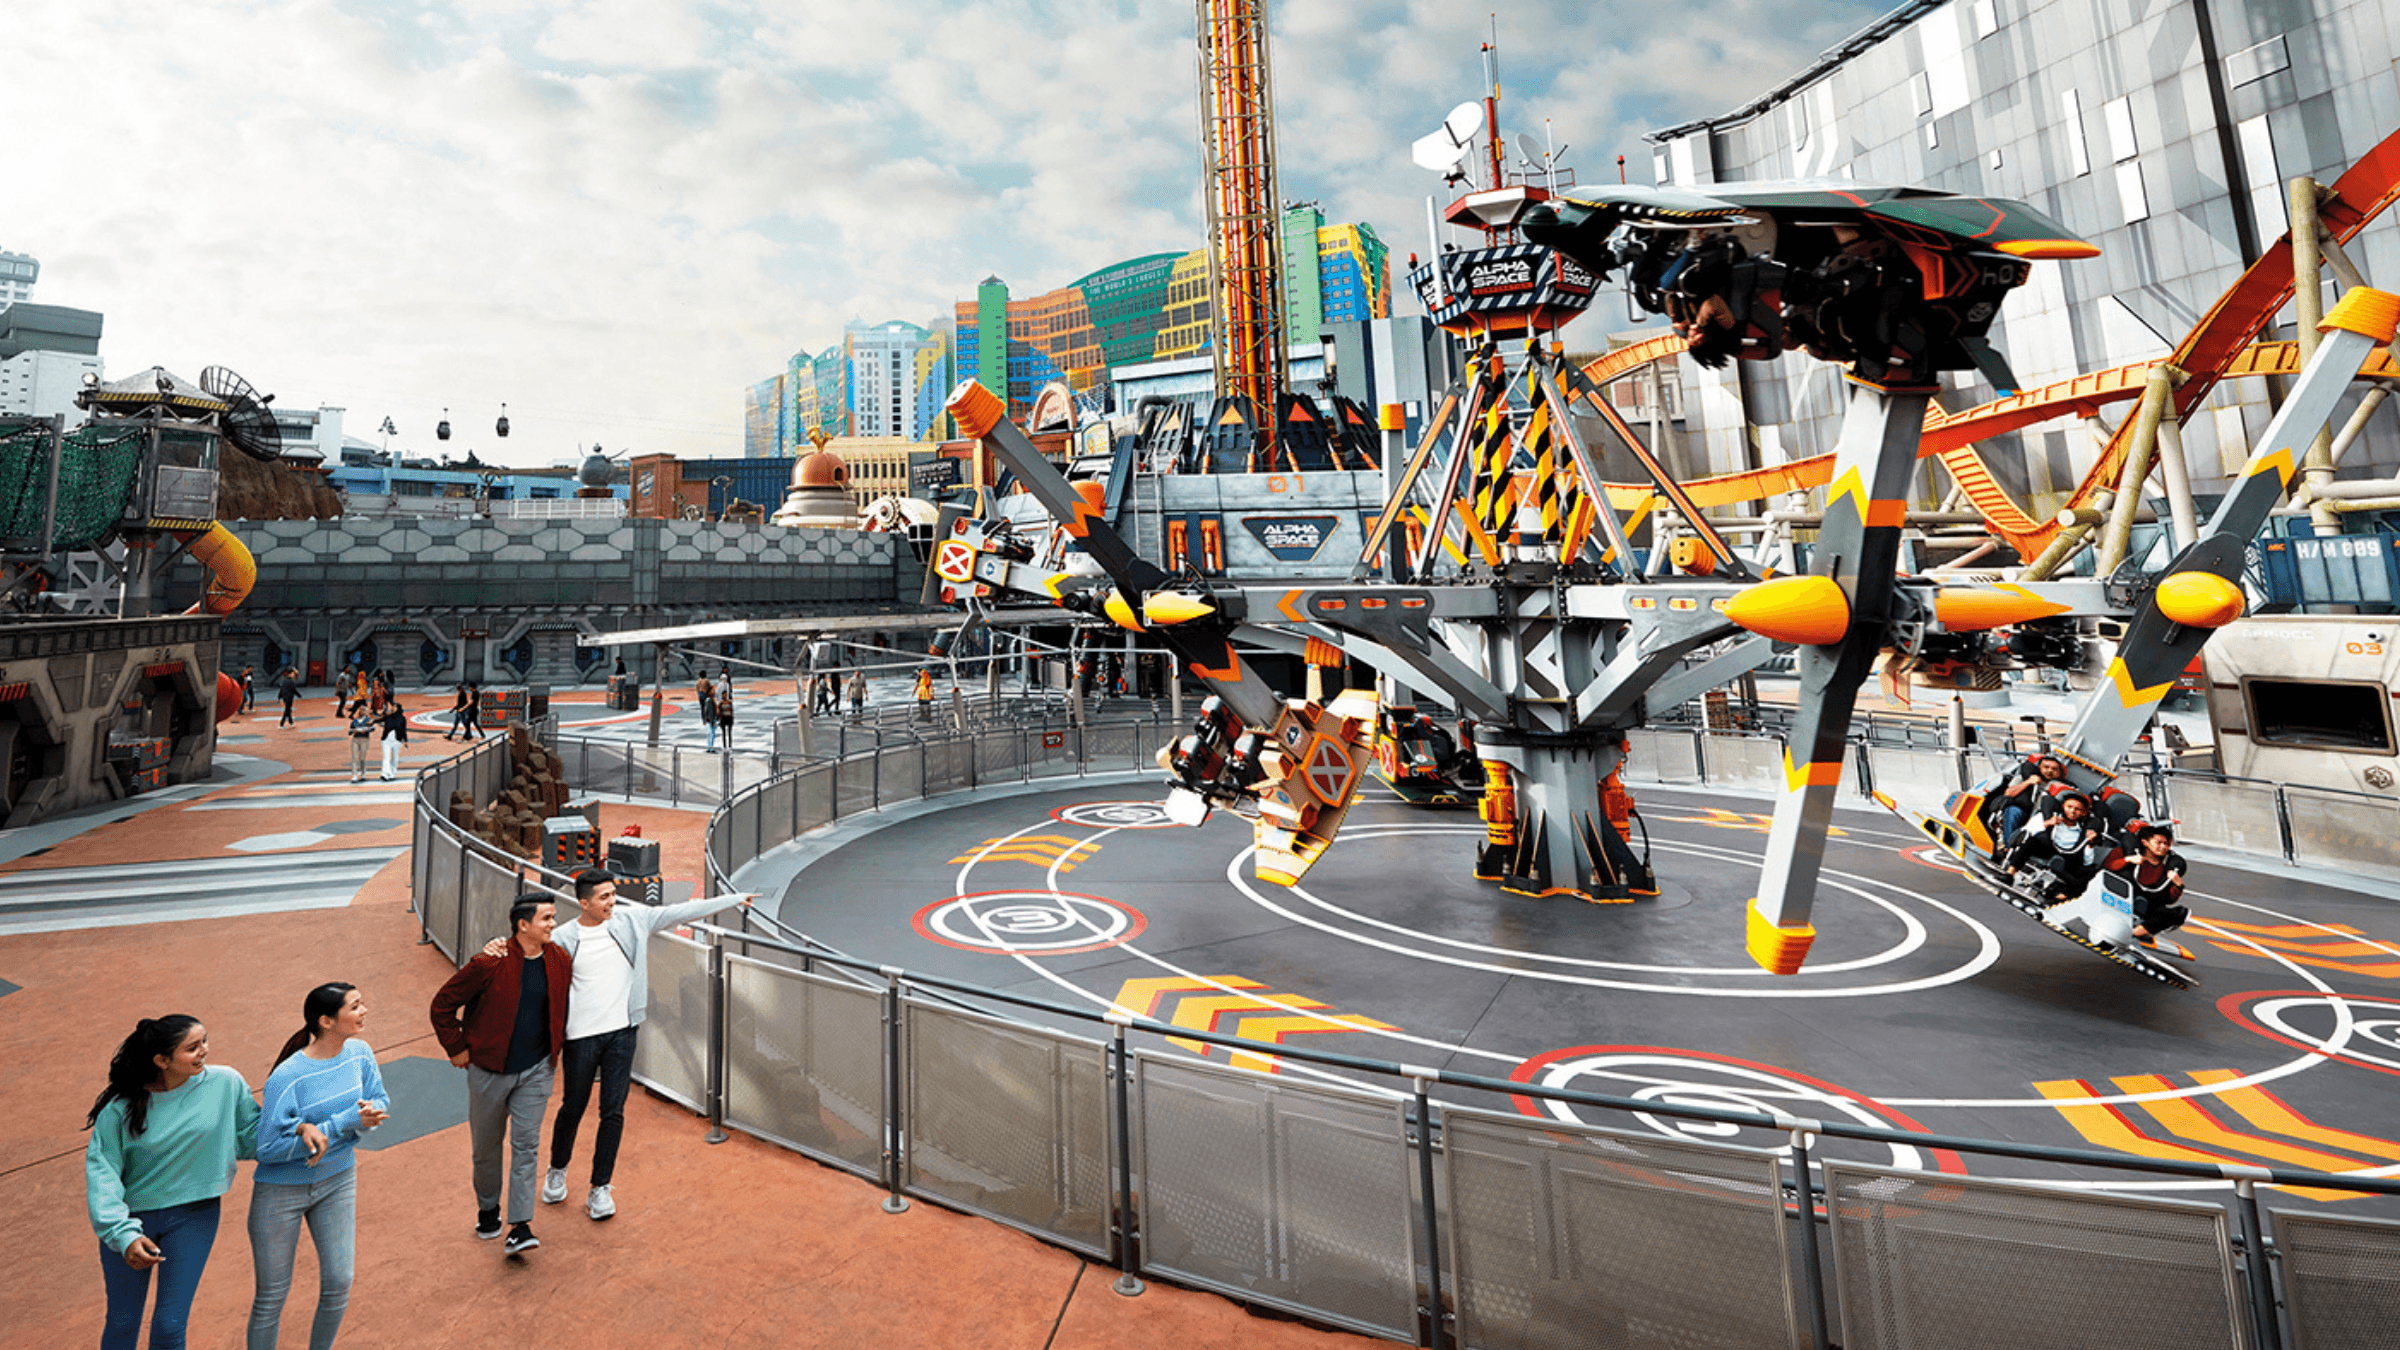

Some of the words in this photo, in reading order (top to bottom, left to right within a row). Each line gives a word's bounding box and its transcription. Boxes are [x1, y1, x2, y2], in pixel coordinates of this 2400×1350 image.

[1470, 260, 1531, 278] ALPHA
[1472, 271, 1530, 288] SPACE
[1268, 475, 1303, 492] 01
[1263, 523, 1320, 535] ALPHA
[1264, 535, 1320, 545] SPACE
[2296, 542, 2337, 559] H/M
[2346, 642, 2383, 655] 03
